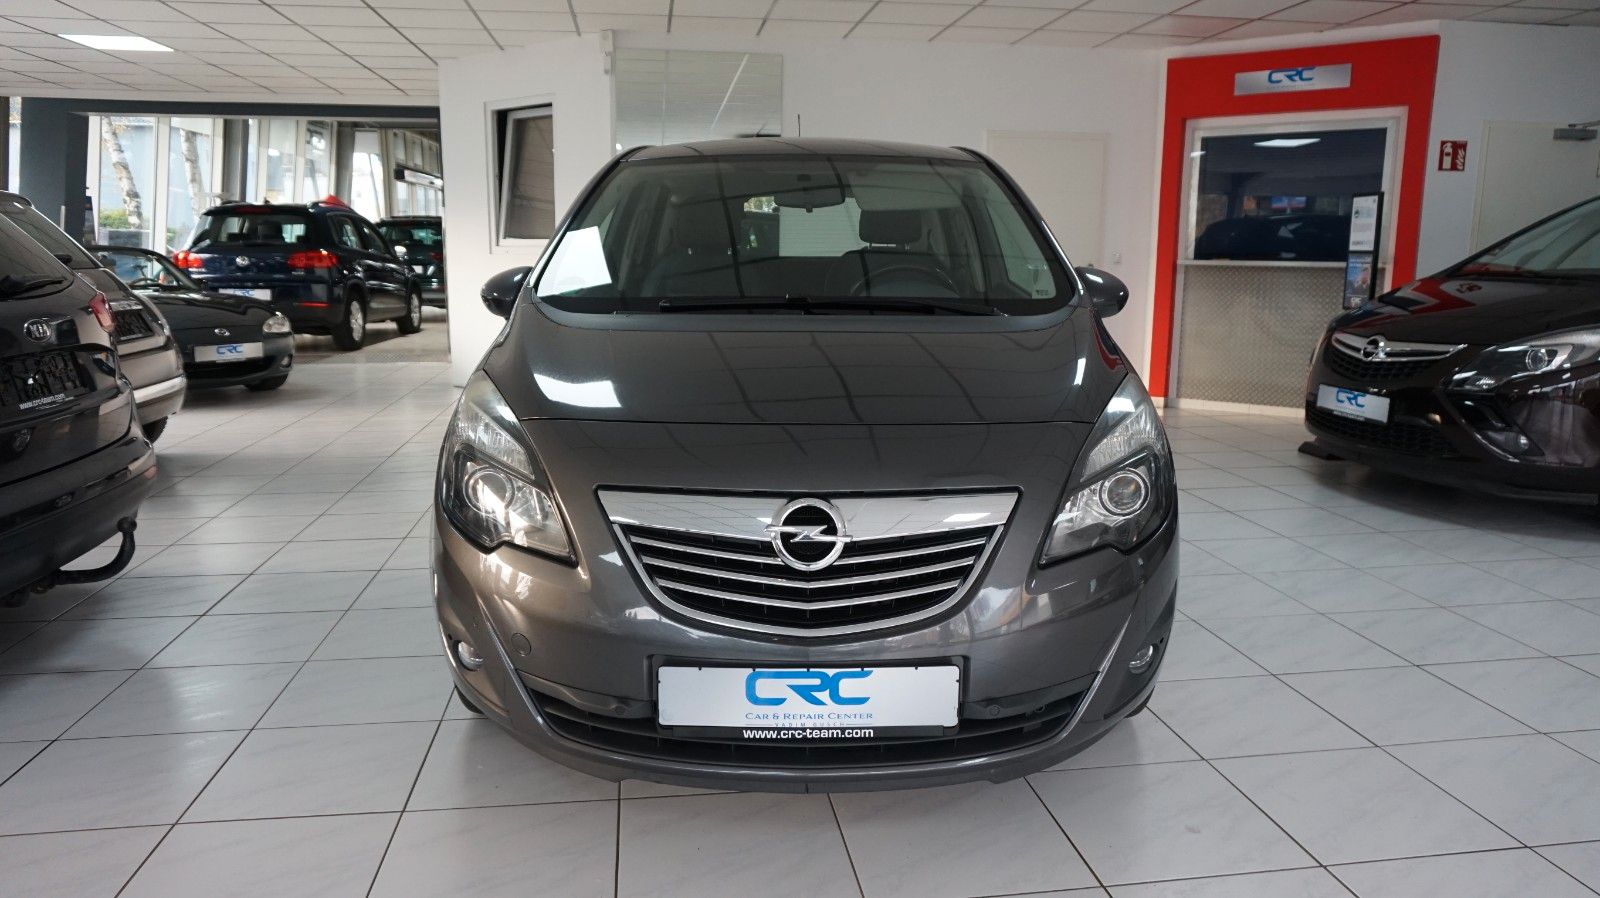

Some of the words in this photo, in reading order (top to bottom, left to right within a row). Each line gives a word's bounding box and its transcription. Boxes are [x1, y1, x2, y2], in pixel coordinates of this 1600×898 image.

[1268, 67, 1316, 84] CRC
[216, 344, 243, 355] CRC
[1336, 387, 1367, 408] CRC
[745, 670, 874, 706] CRC
[743, 729, 874, 739] www.crc-team.com
